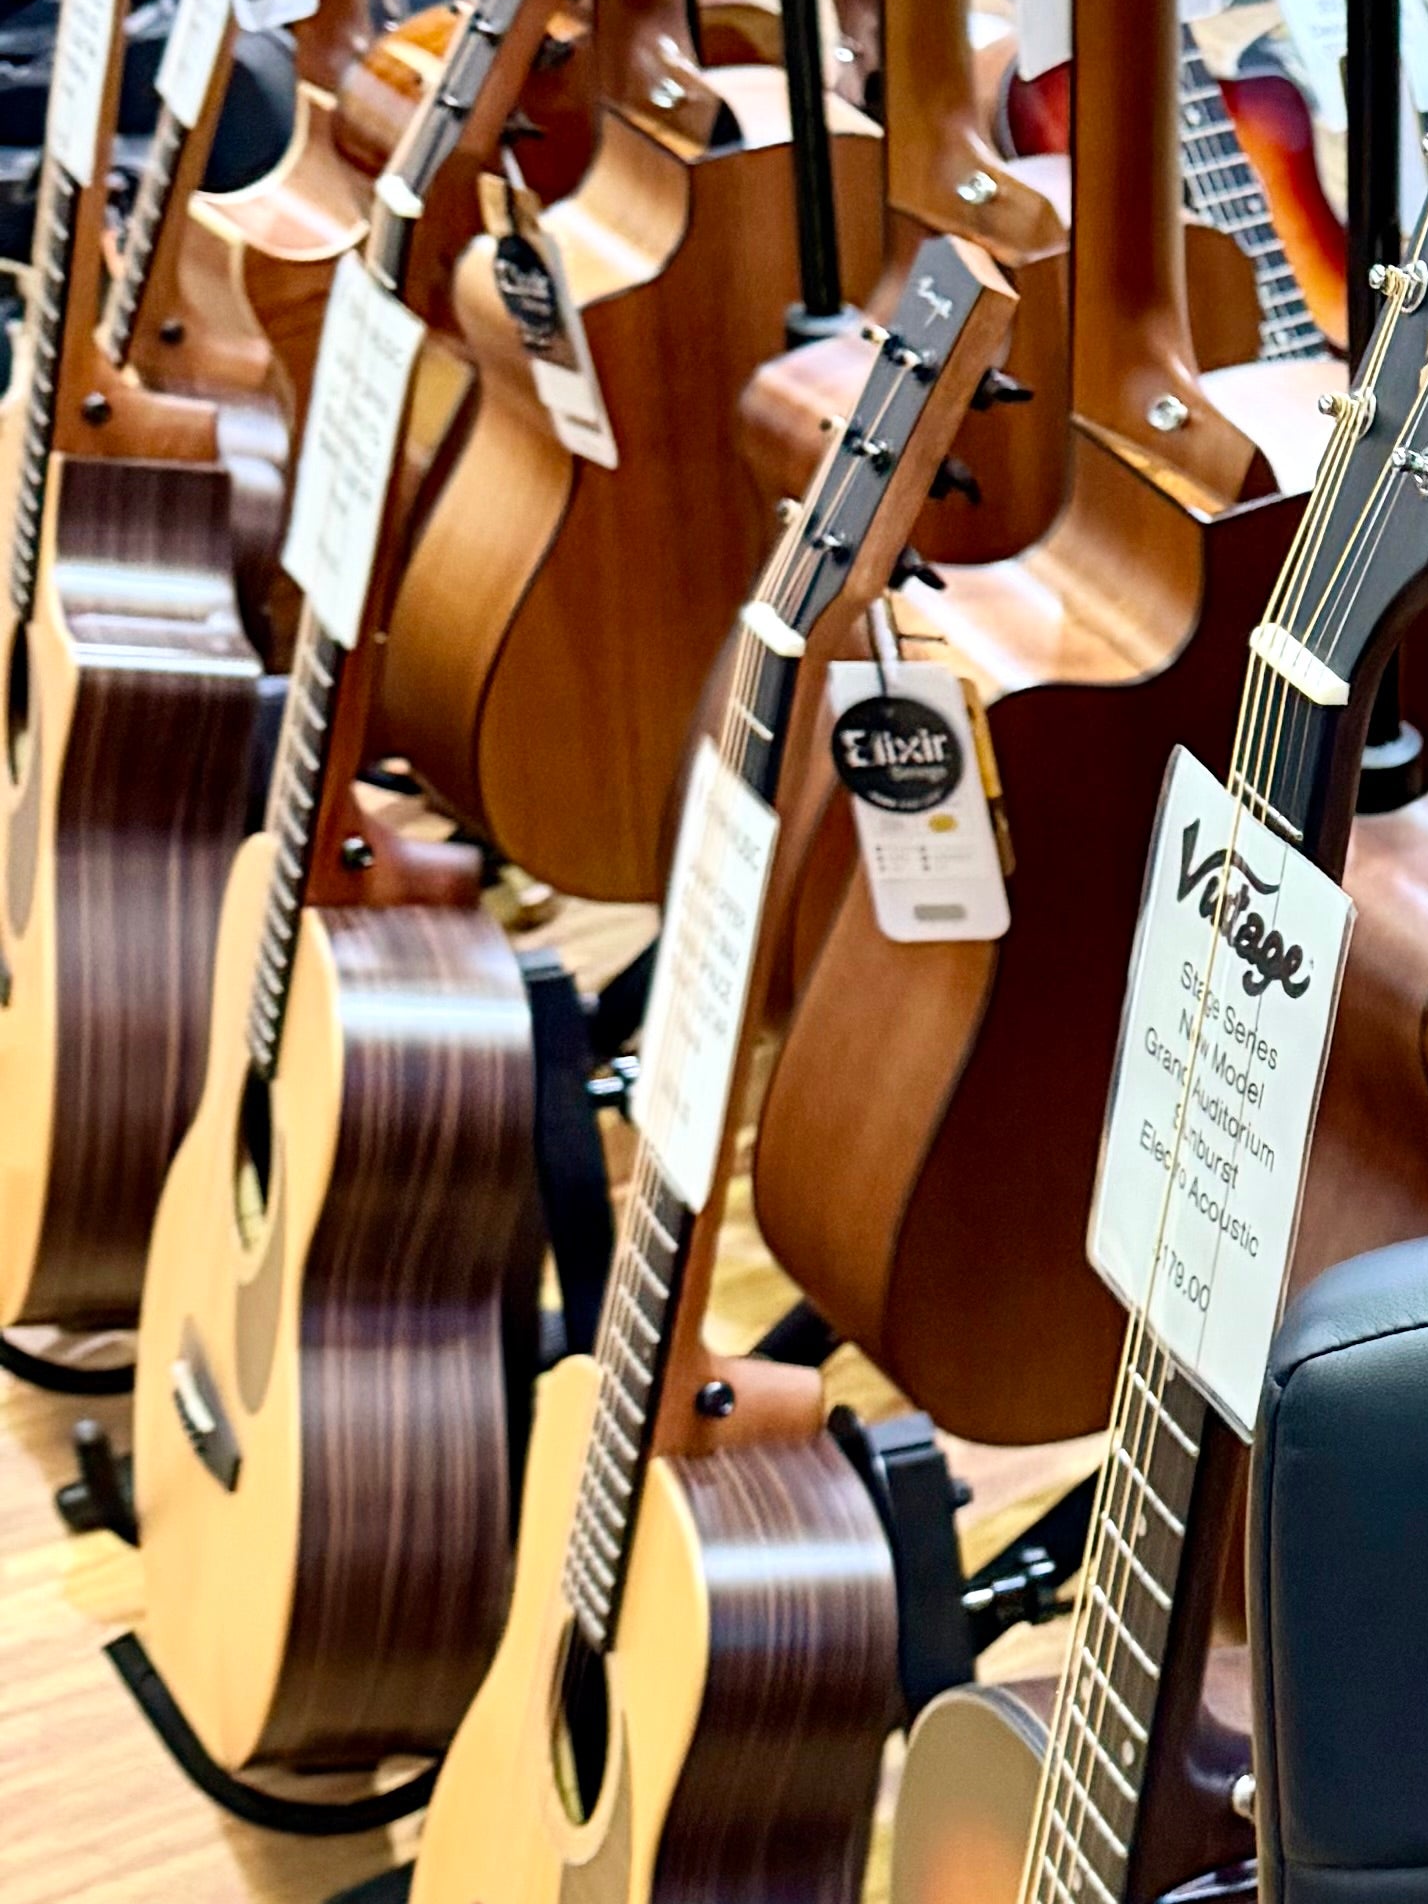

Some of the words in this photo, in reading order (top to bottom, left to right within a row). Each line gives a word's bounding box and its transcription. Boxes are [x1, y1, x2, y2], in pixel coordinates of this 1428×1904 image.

[840, 727, 949, 768] Elixir
[1175, 817, 1311, 999] Vintage
[1179, 1007, 1210, 1059] Nw
[1212, 1041, 1266, 1110] Model
[1223, 1005, 1279, 1071] Series
[1173, 1102, 1240, 1190] Snburst
[1191, 1078, 1276, 1173] Auditorium
[1139, 1118, 1187, 1189] Elecro
[1187, 1179, 1260, 1258] Acoustic
